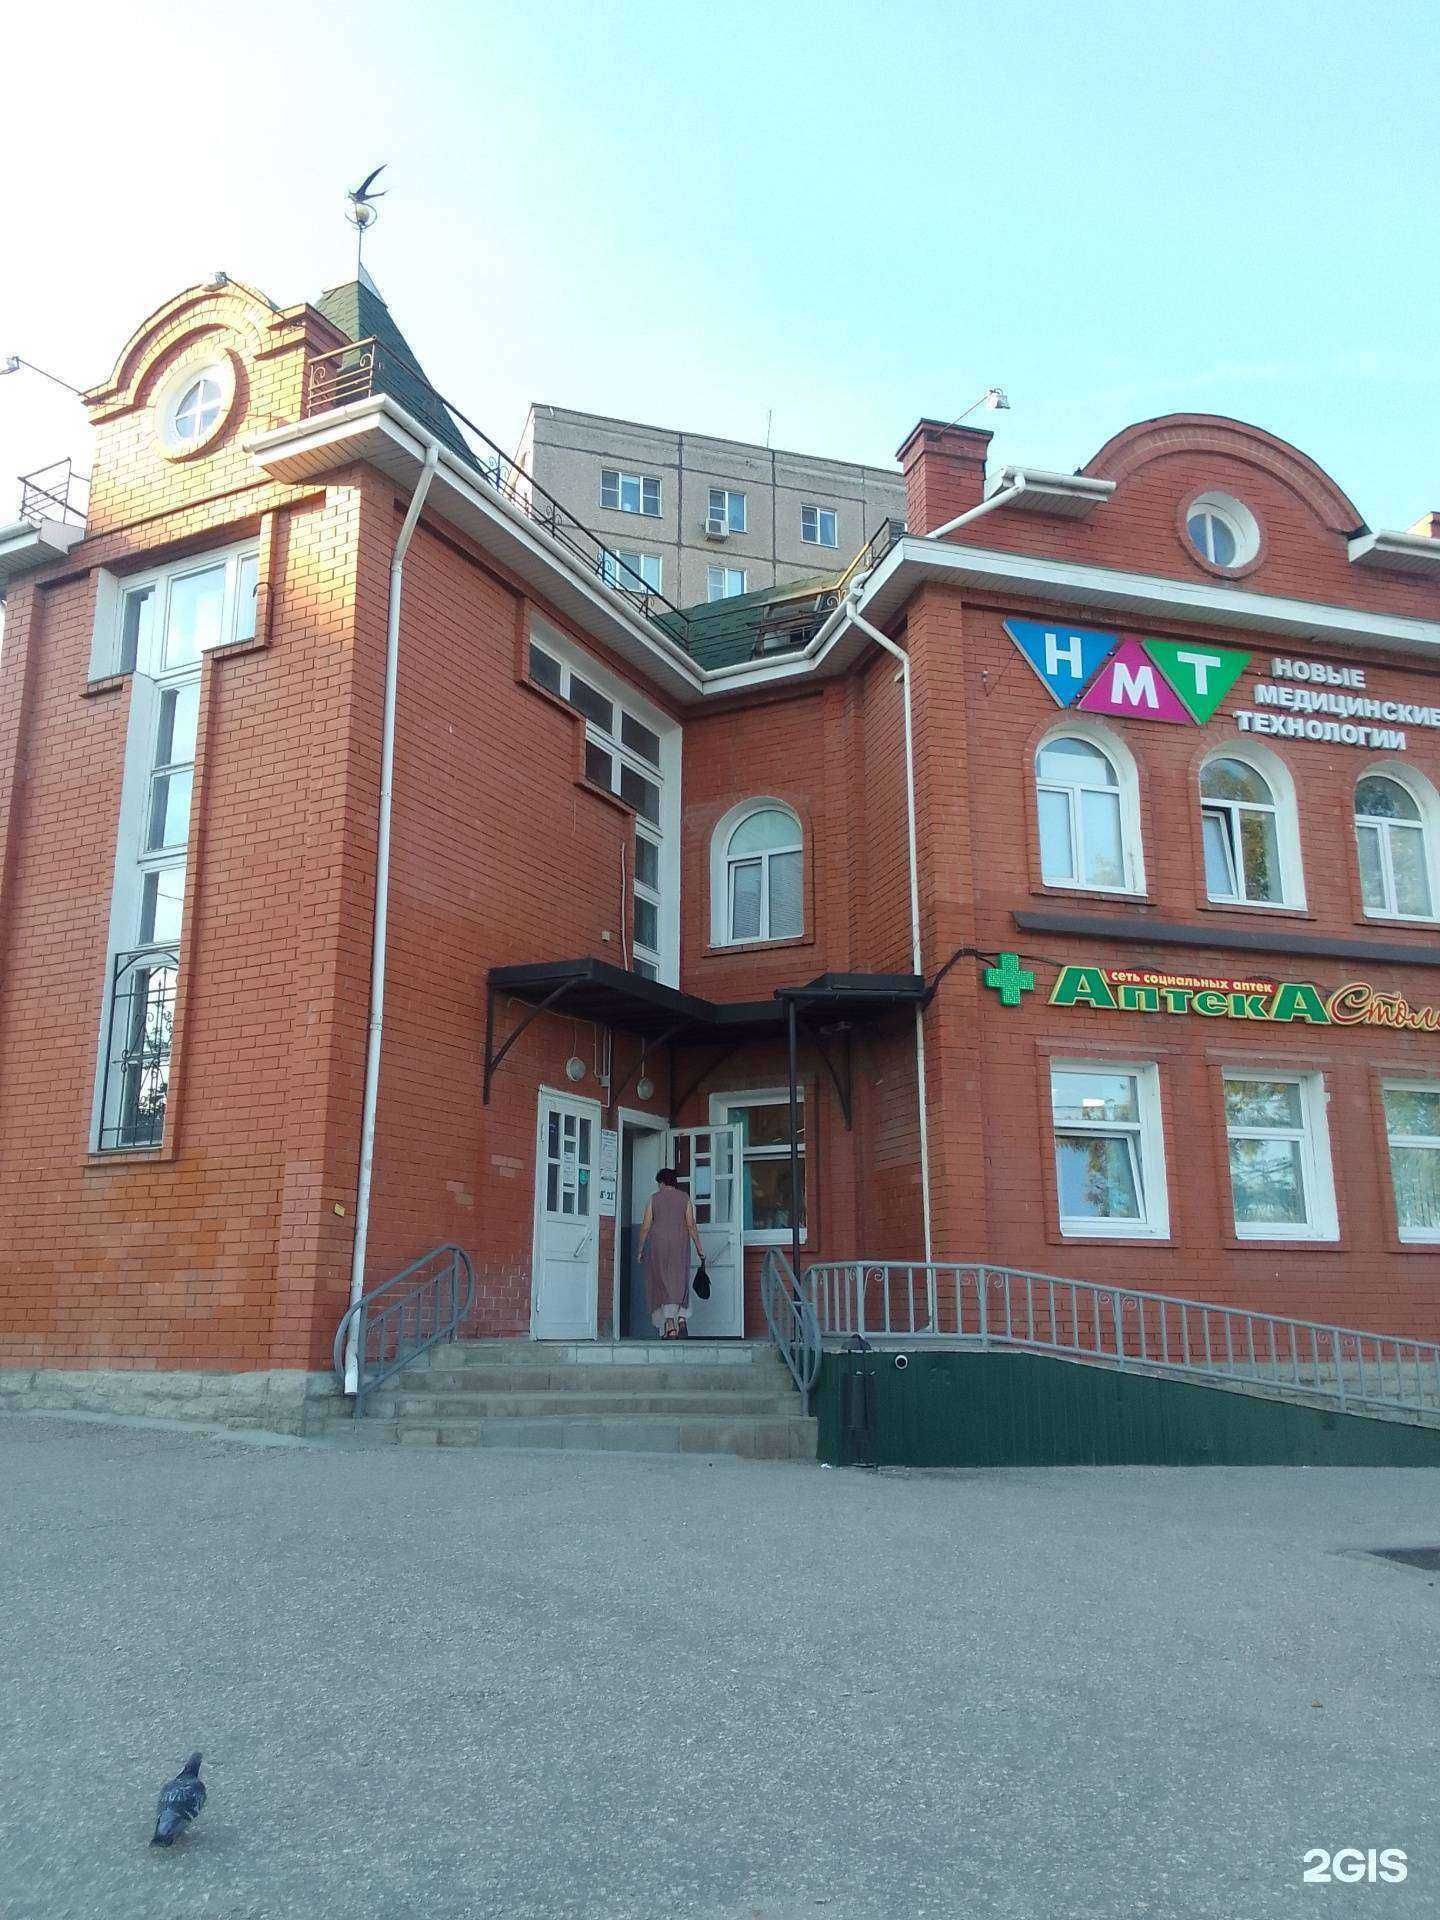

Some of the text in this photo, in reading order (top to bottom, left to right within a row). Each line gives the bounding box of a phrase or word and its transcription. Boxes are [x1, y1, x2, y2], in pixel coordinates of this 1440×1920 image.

[1271, 657, 1367, 690] НОВЫЕ
[1254, 684, 1440, 728] МЕДИЦИНСКИЕ
[1234, 710, 1407, 750] ТЕХНОЛОГИИ
[1111, 971, 1273, 993] сеть социальных аптек
[1327, 982, 1440, 1031] Стол
